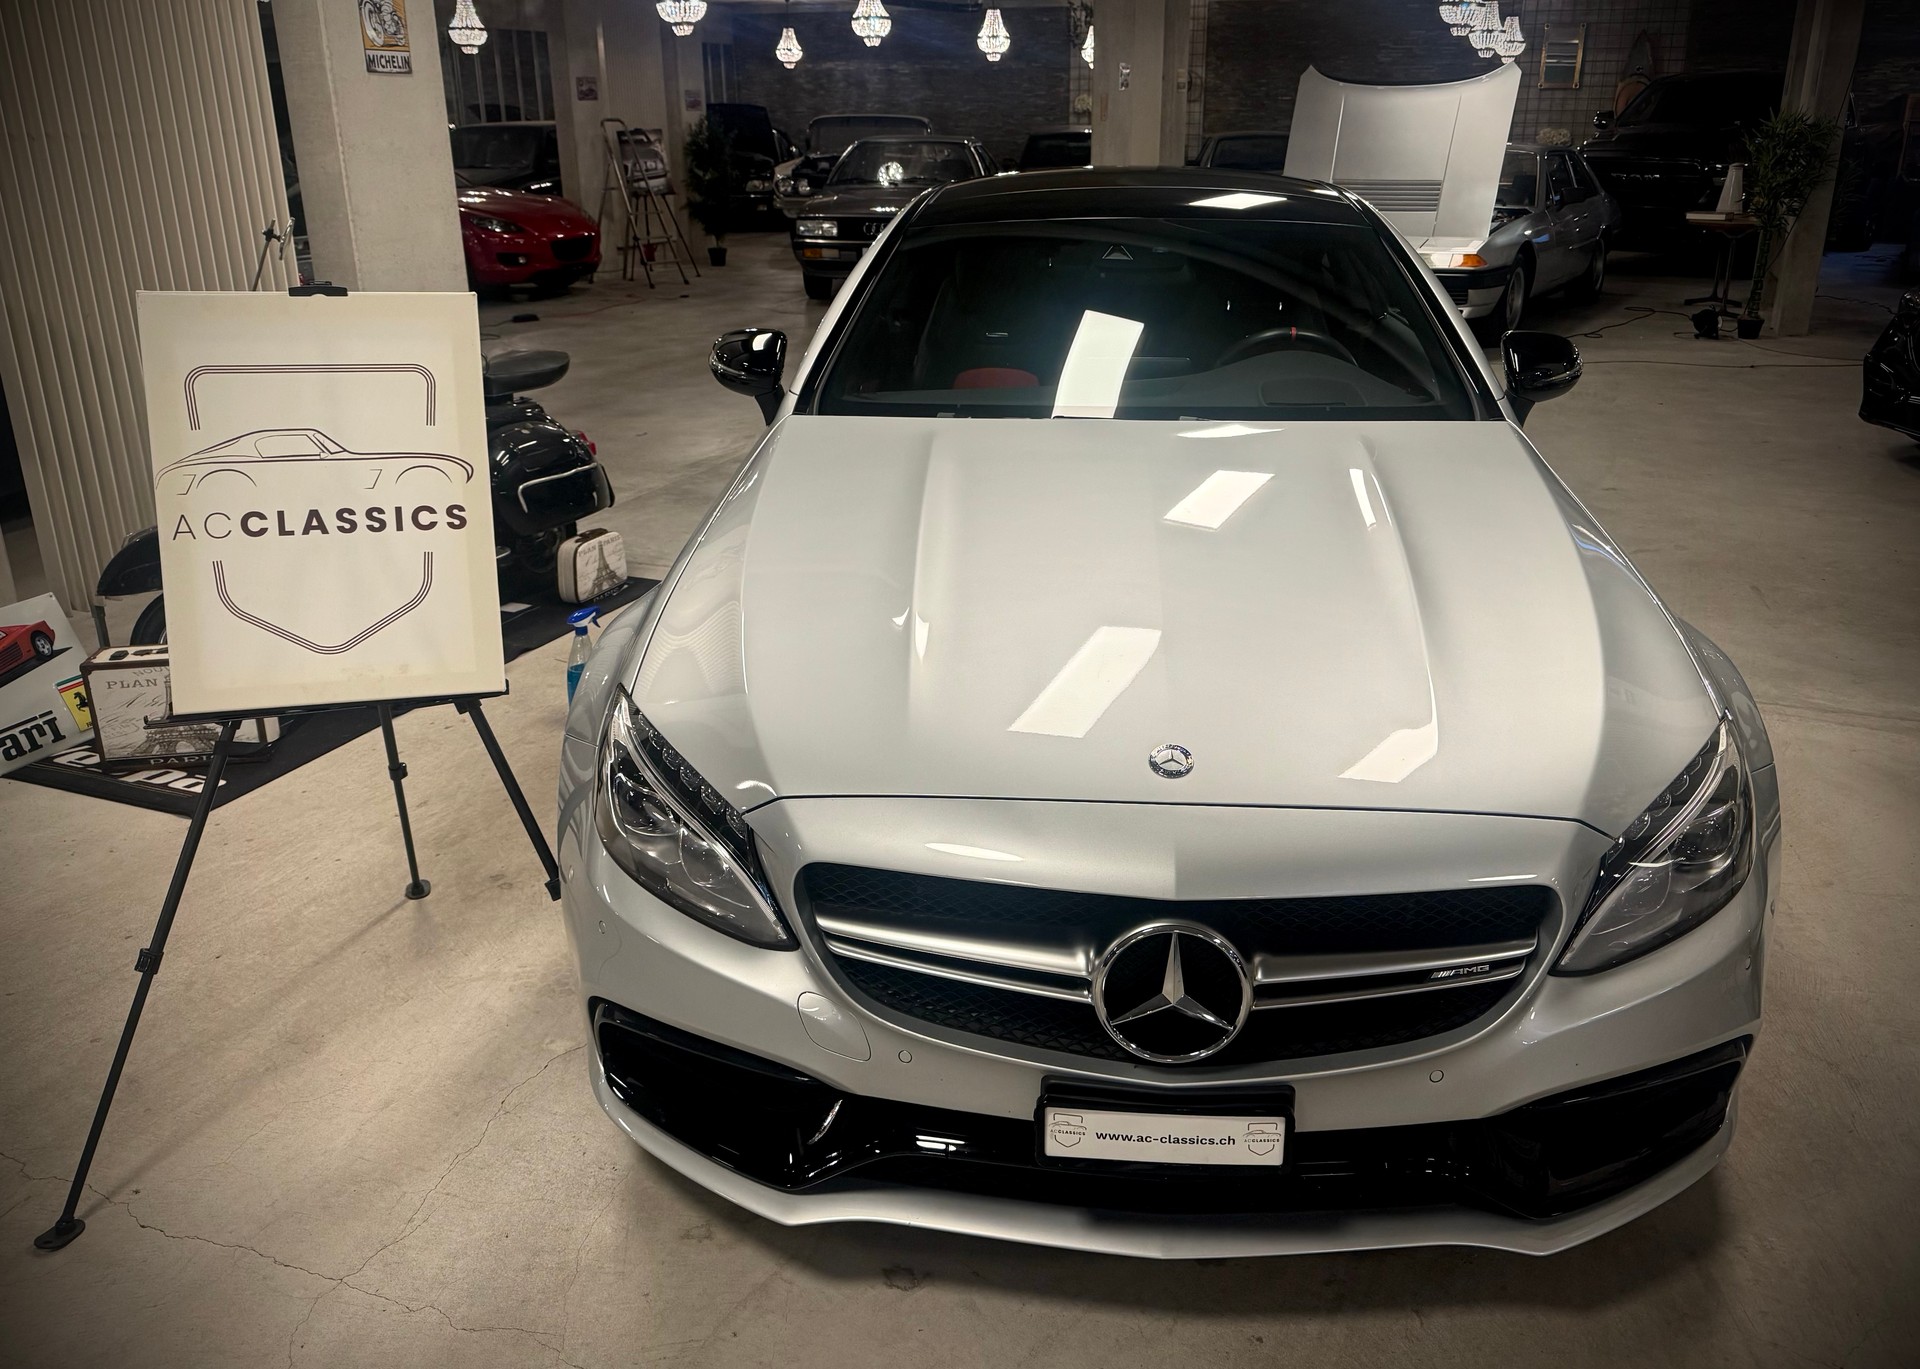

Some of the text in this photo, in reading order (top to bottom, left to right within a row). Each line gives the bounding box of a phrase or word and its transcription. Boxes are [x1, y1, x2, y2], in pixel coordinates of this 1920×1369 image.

[367, 54, 411, 70] MICHELIN
[105, 678, 158, 690] PLAN
[1095, 1130, 1236, 1147] www.ac-classics.ch
